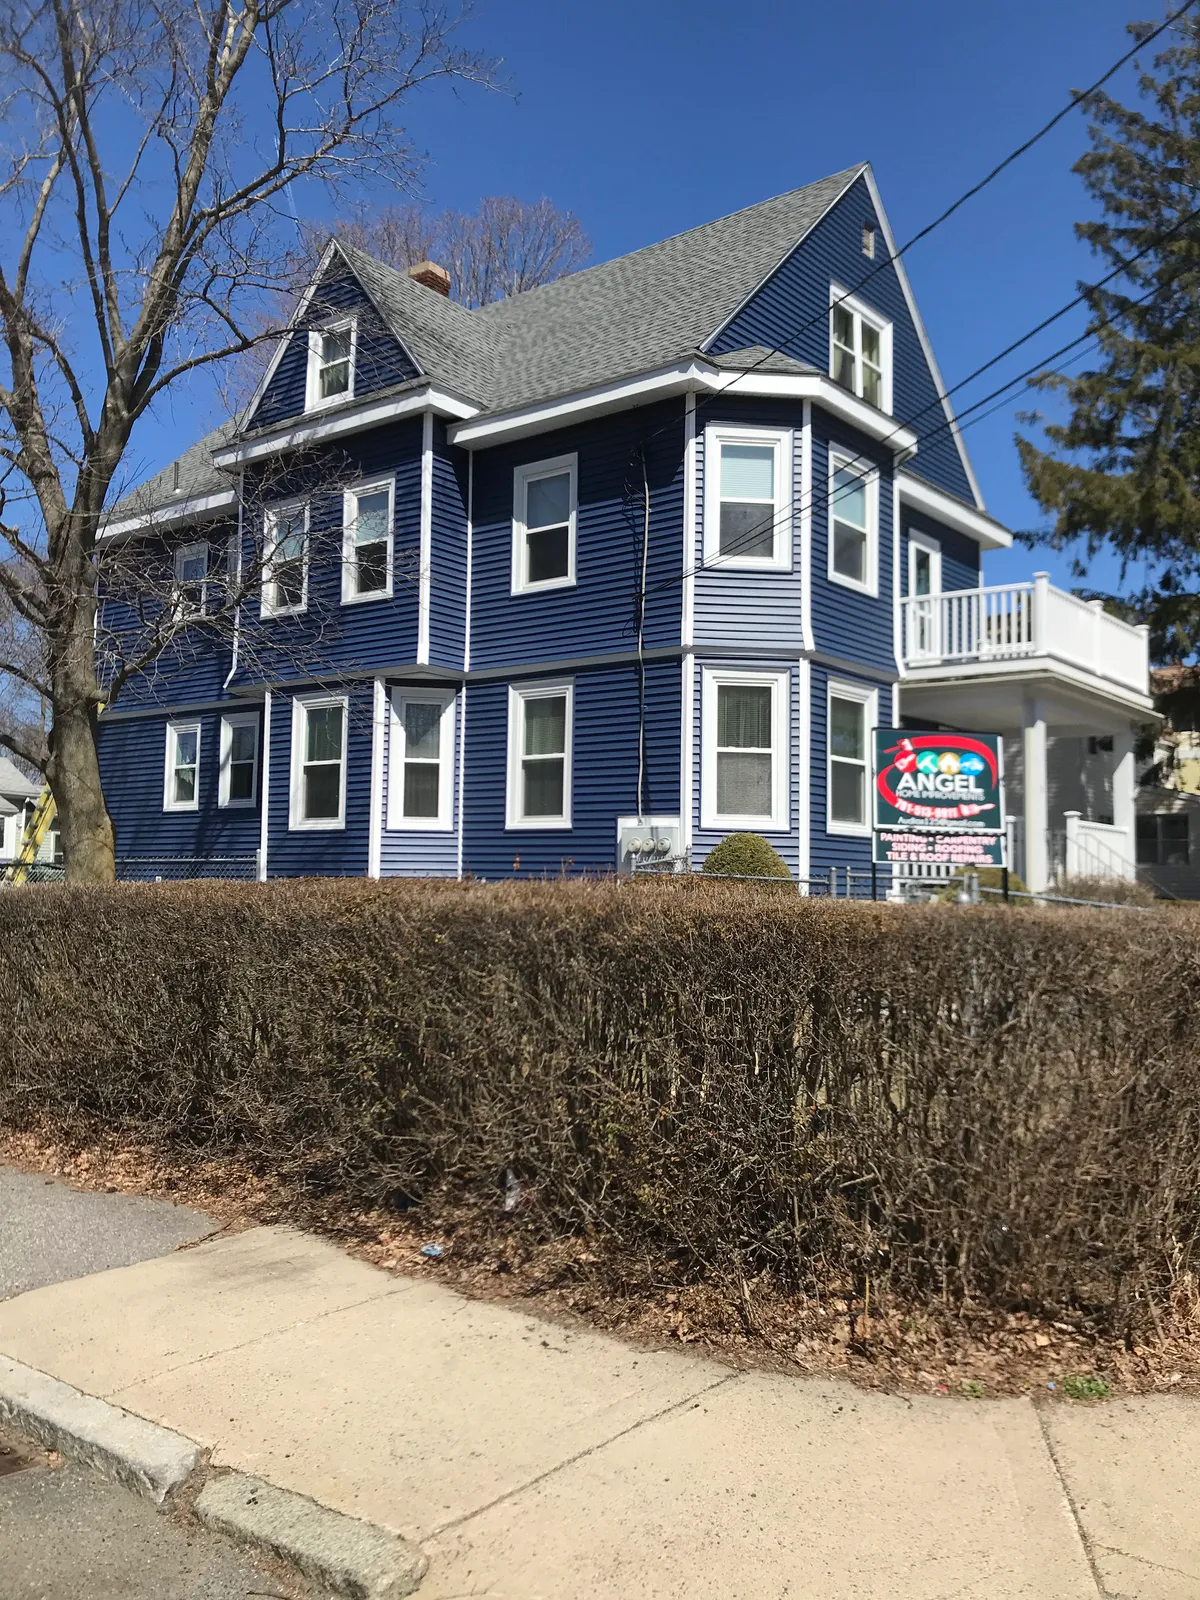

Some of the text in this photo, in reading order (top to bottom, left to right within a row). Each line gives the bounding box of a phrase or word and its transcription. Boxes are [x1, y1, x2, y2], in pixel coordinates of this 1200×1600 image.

[896, 772, 984, 792] ANGEL
[896, 789, 985, 801] HOME IMPROVEMENTS
[880, 832, 997, 846] PAINTING CARPENTRY
[892, 842, 984, 855] SIDING ROOFING
[886, 851, 994, 864] TILE & ROOF REPAIRS
